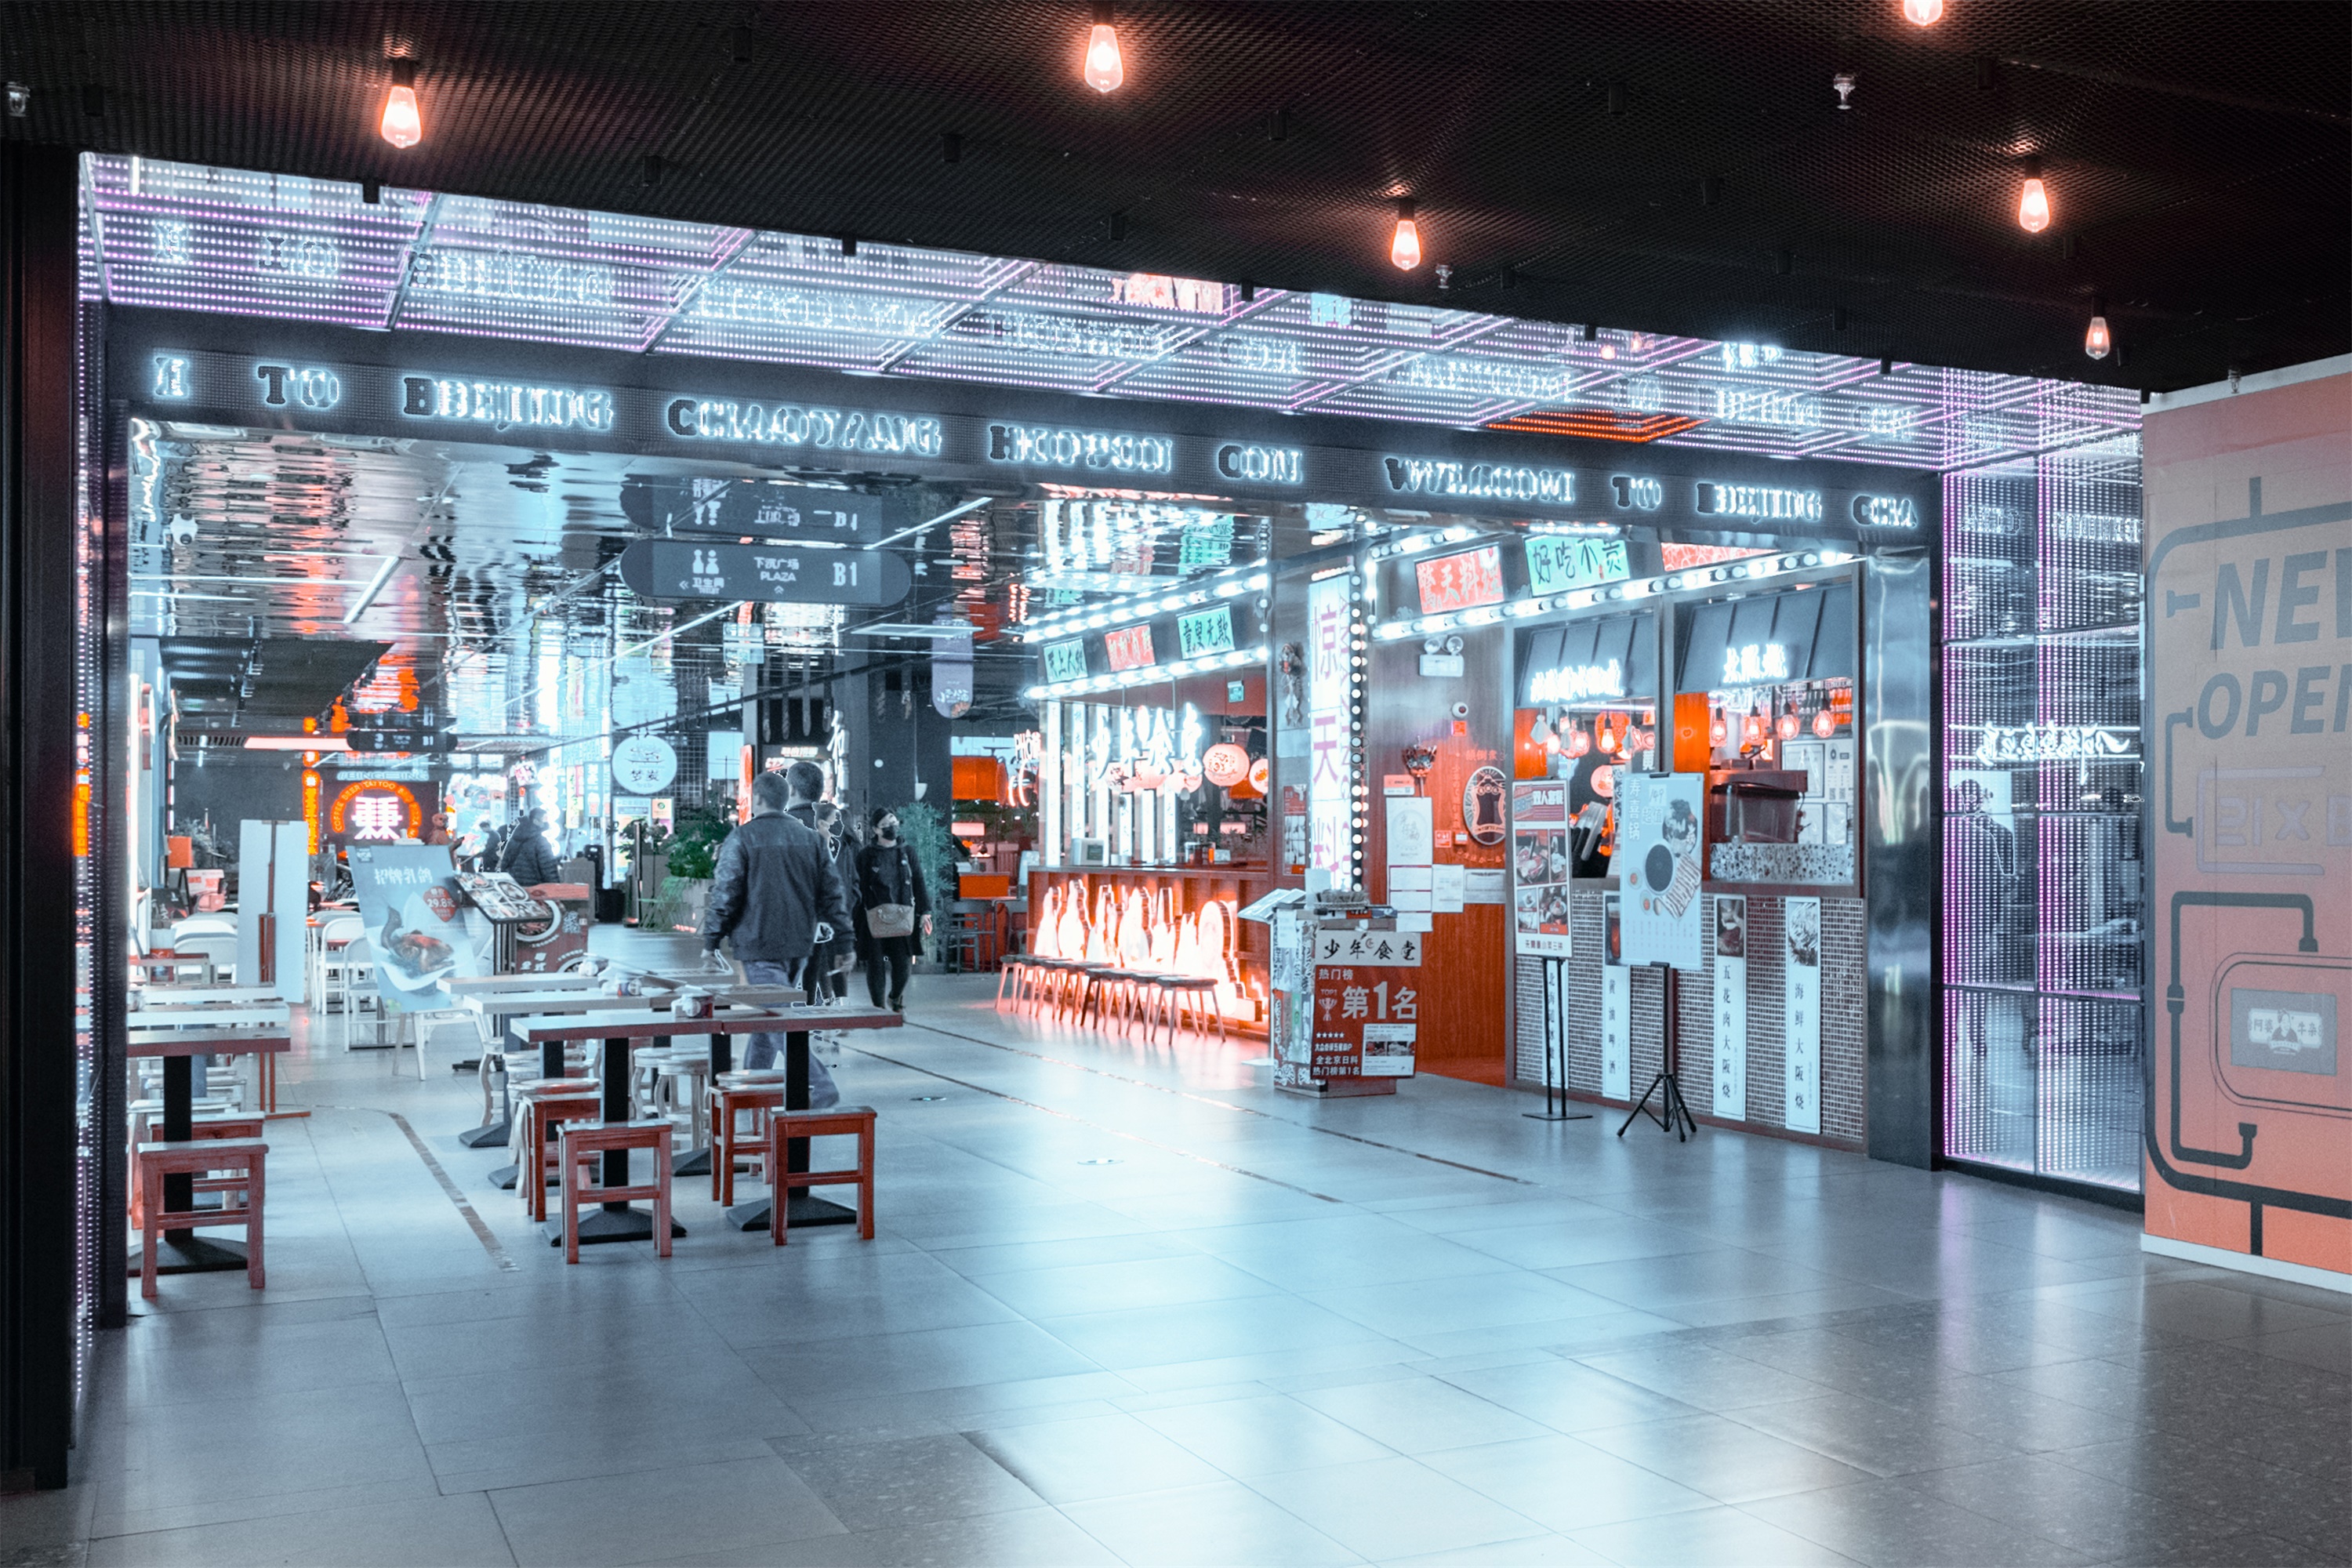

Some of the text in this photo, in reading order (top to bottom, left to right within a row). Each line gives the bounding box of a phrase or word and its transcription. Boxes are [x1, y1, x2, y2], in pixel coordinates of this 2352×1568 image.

[753, 557, 800, 571] 下沉广场
[833, 561, 858, 587] B1
[692, 578, 725, 589] 卫生间
[760, 572, 797, 582] PLAZA
[2210, 550, 2352, 651] NE
[1628, 778, 1641, 840] 寿喜锅
[375, 866, 433, 885] 招牌乳鸽
[1323, 938, 1416, 961] 少年食堂
[1319, 968, 1354, 980] 热门榜
[1341, 981, 1417, 1020] 第1名
[1722, 964, 1731, 1099] 五花肉大阪烧
[1794, 982, 1805, 1110] 海鲜大阪烧
[1316, 1055, 1359, 1065] 全北京日料
[1312, 1066, 1360, 1076] 热门榜第1名
